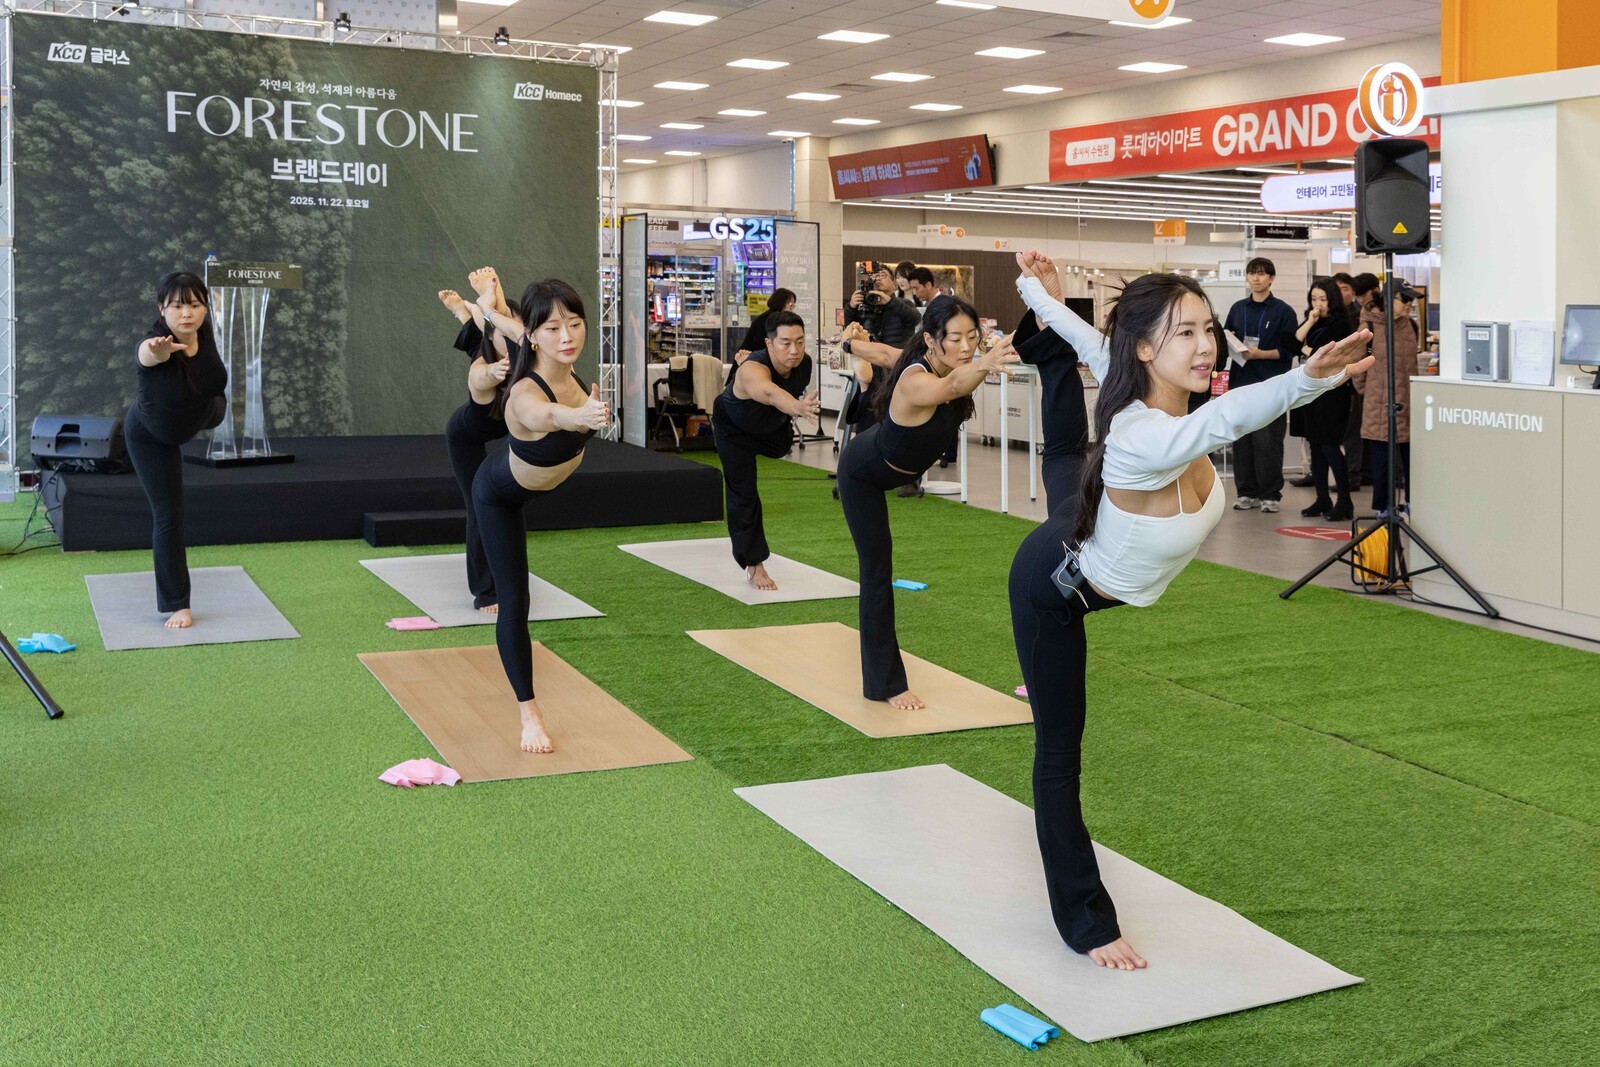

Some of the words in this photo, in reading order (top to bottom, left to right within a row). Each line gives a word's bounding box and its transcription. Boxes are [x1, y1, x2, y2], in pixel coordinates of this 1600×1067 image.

[52, 43, 83, 60] KCC
[91, 47, 130, 65] 글라스
[259, 79, 292, 92] 자연의
[295, 81, 319, 95] 감성,
[322, 84, 353, 97] 석재의
[355, 86, 397, 100] 아름다움
[517, 84, 541, 98] KCC
[545, 89, 582, 102] Homecc
[166, 90, 480, 153] FORESTONE
[1120, 126, 1203, 159] 롯데하이마트
[1212, 102, 1338, 156] GRAND
[1091, 144, 1109, 157] 수원점
[270, 157, 388, 188] 브랜드데이
[290, 196, 316, 205] 2025.
[318, 197, 329, 206] 11.
[330, 198, 345, 207] 22.
[345, 198, 369, 209] 토요일
[1296, 185, 1327, 199] 인테리어
[709, 216, 774, 241] GS25
[228, 269, 282, 280] FORESTONE
[1438, 407, 1543, 433] INFORMATION
